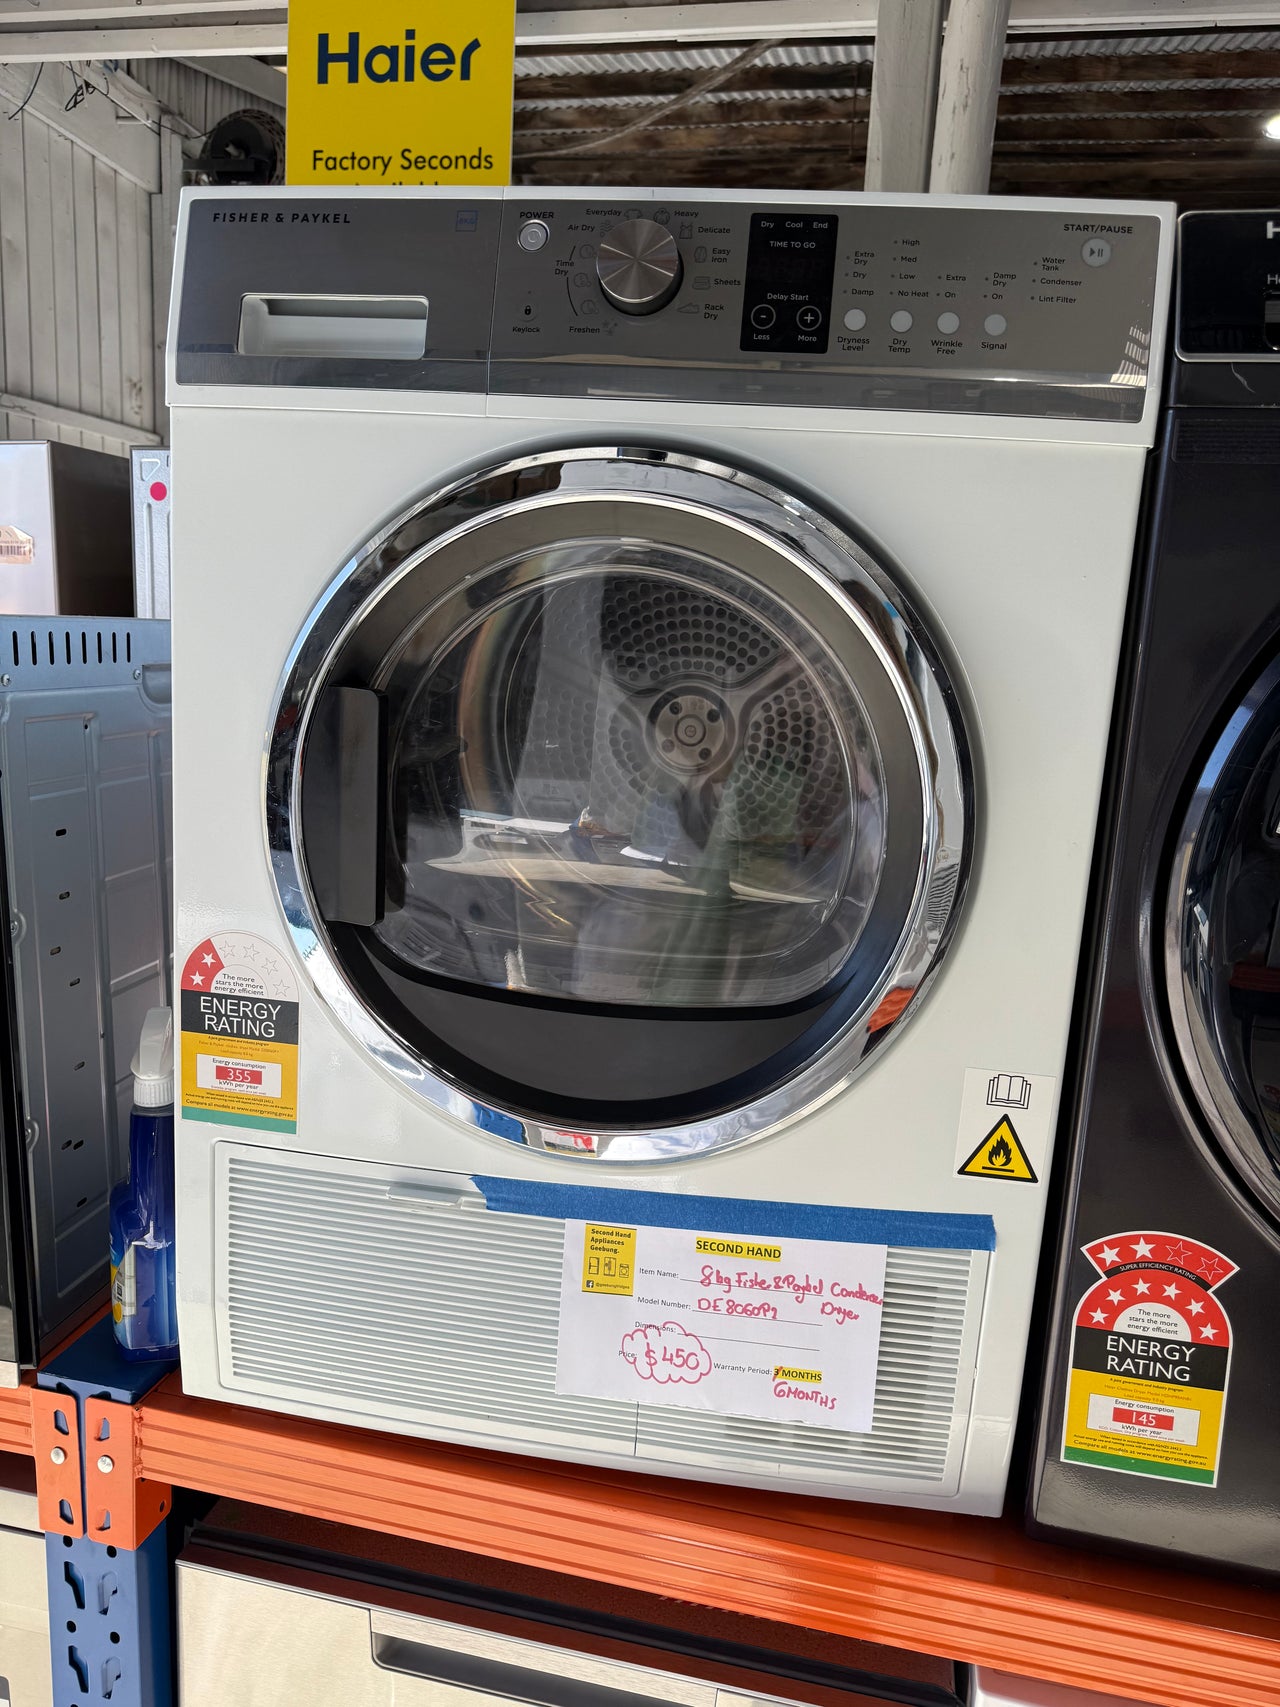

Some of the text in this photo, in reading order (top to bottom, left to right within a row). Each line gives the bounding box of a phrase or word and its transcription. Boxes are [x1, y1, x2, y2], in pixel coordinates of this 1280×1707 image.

[317, 28, 481, 85] Haier
[312, 147, 494, 176] Factory Seconds
[519, 211, 555, 219] POWER
[585, 208, 622, 217] Everyday
[674, 209, 699, 218] Heavy
[212, 212, 351, 224] FISHER & PAYKEL
[567, 224, 595, 233] Air Dry
[760, 221, 775, 229] Dry
[785, 221, 803, 229] Cool
[813, 221, 828, 229] End
[1063, 223, 1133, 234] START/PAUSE
[698, 226, 731, 234] Delicate
[803, 241, 816, 249] GO
[902, 239, 920, 247] High
[712, 248, 731, 256] Easy
[854, 258, 868, 266] Dry
[554, 269, 569, 277] Dry
[993, 272, 1017, 280] Damp
[713, 278, 741, 286] Sheets
[992, 280, 1007, 288] Dry
[1040, 278, 1082, 286] Condenser
[767, 293, 809, 301] Delay Start
[911, 290, 929, 298] Heat
[1038, 295, 1077, 304] Lint Filter
[703, 312, 719, 320] Dry
[512, 326, 540, 334] Keylock
[753, 333, 770, 341] Less
[837, 336, 870, 345] Dryness
[892, 338, 907, 346] Dry
[931, 340, 963, 348] Wrinkle
[981, 341, 1007, 351] Signal
[222, 973, 236, 981] The
[214, 985, 264, 996] energy efficient
[200, 996, 281, 1021] ENERGY
[204, 1014, 275, 1038] RATING
[212, 1058, 267, 1070] Energy consumption
[227, 1068, 251, 1082] 355
[218, 1079, 234, 1087] kWh
[234, 1081, 245, 1089] per
[591, 1228, 632, 1239] Second Hand
[590, 1236, 625, 1246] Appliances
[590, 1244, 620, 1254] Geebung.
[696, 1239, 781, 1259] SECOND HAND
[639, 1267, 679, 1279] Item Name:
[1119, 1262, 1197, 1281] SUPER EFFICIENCY RATING
[637, 1296, 691, 1310] Model Number:
[1137, 1308, 1151, 1316] The
[634, 1321, 677, 1333] Dimensions:
[1159, 1320, 1178, 1328] more
[1127, 1323, 1178, 1336] energy efficient
[1106, 1335, 1197, 1362] ENERGY
[618, 1350, 638, 1359] Price:
[713, 1362, 746, 1373] Warranty
[747, 1366, 773, 1376] Period:
[781, 1370, 823, 1382] MONTHS
[1107, 1355, 1191, 1382] RATING
[1114, 1399, 1175, 1413] Energy consumption
[1132, 1411, 1156, 1427] 145
[1121, 1423, 1137, 1431] kWh
